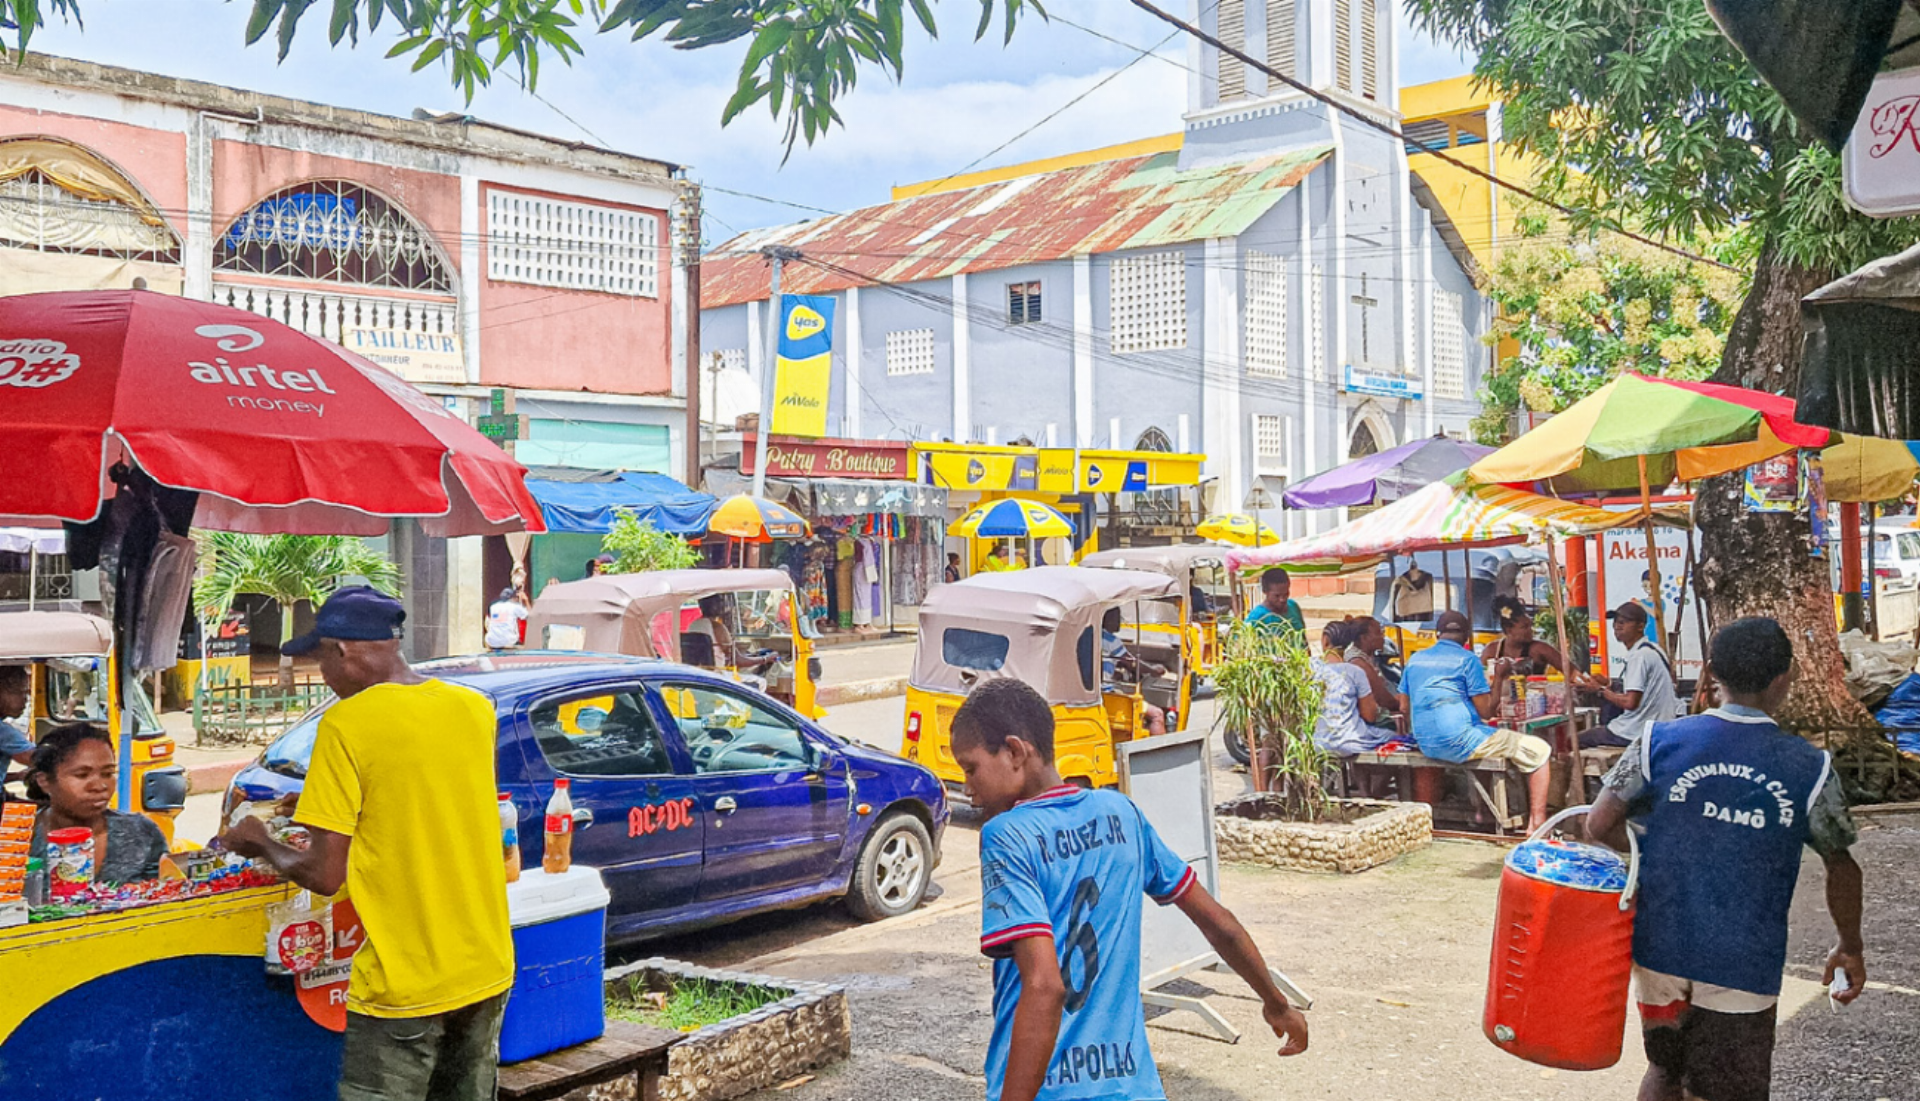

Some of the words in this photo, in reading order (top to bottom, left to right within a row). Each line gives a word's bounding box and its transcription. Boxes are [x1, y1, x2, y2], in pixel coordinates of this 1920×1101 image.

[351, 329, 455, 352] TAILLEUR
[187, 357, 337, 395] airtel
[226, 395, 325, 418] money
[1106, 814, 1127, 846] JR
[1060, 876, 1099, 1015] 6
